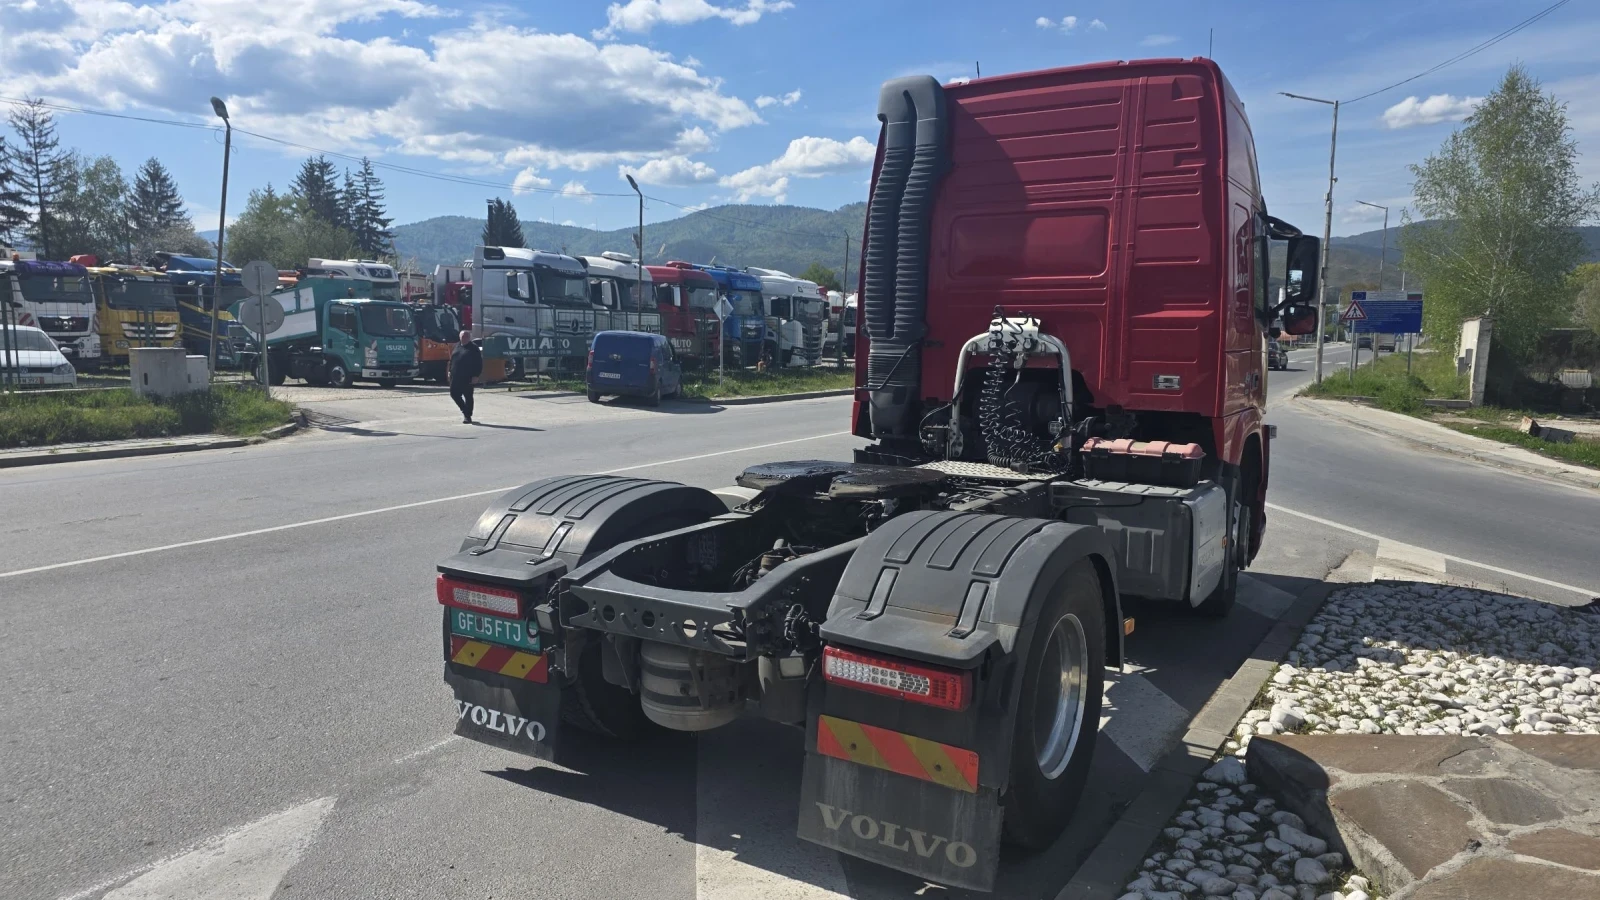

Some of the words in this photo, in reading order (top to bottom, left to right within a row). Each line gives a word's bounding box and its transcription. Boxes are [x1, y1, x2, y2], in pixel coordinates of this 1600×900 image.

[375, 269, 388, 277] XF
[507, 337, 536, 350] VELI
[454, 699, 546, 742] VOLVO
[815, 801, 978, 868] VOLVO
